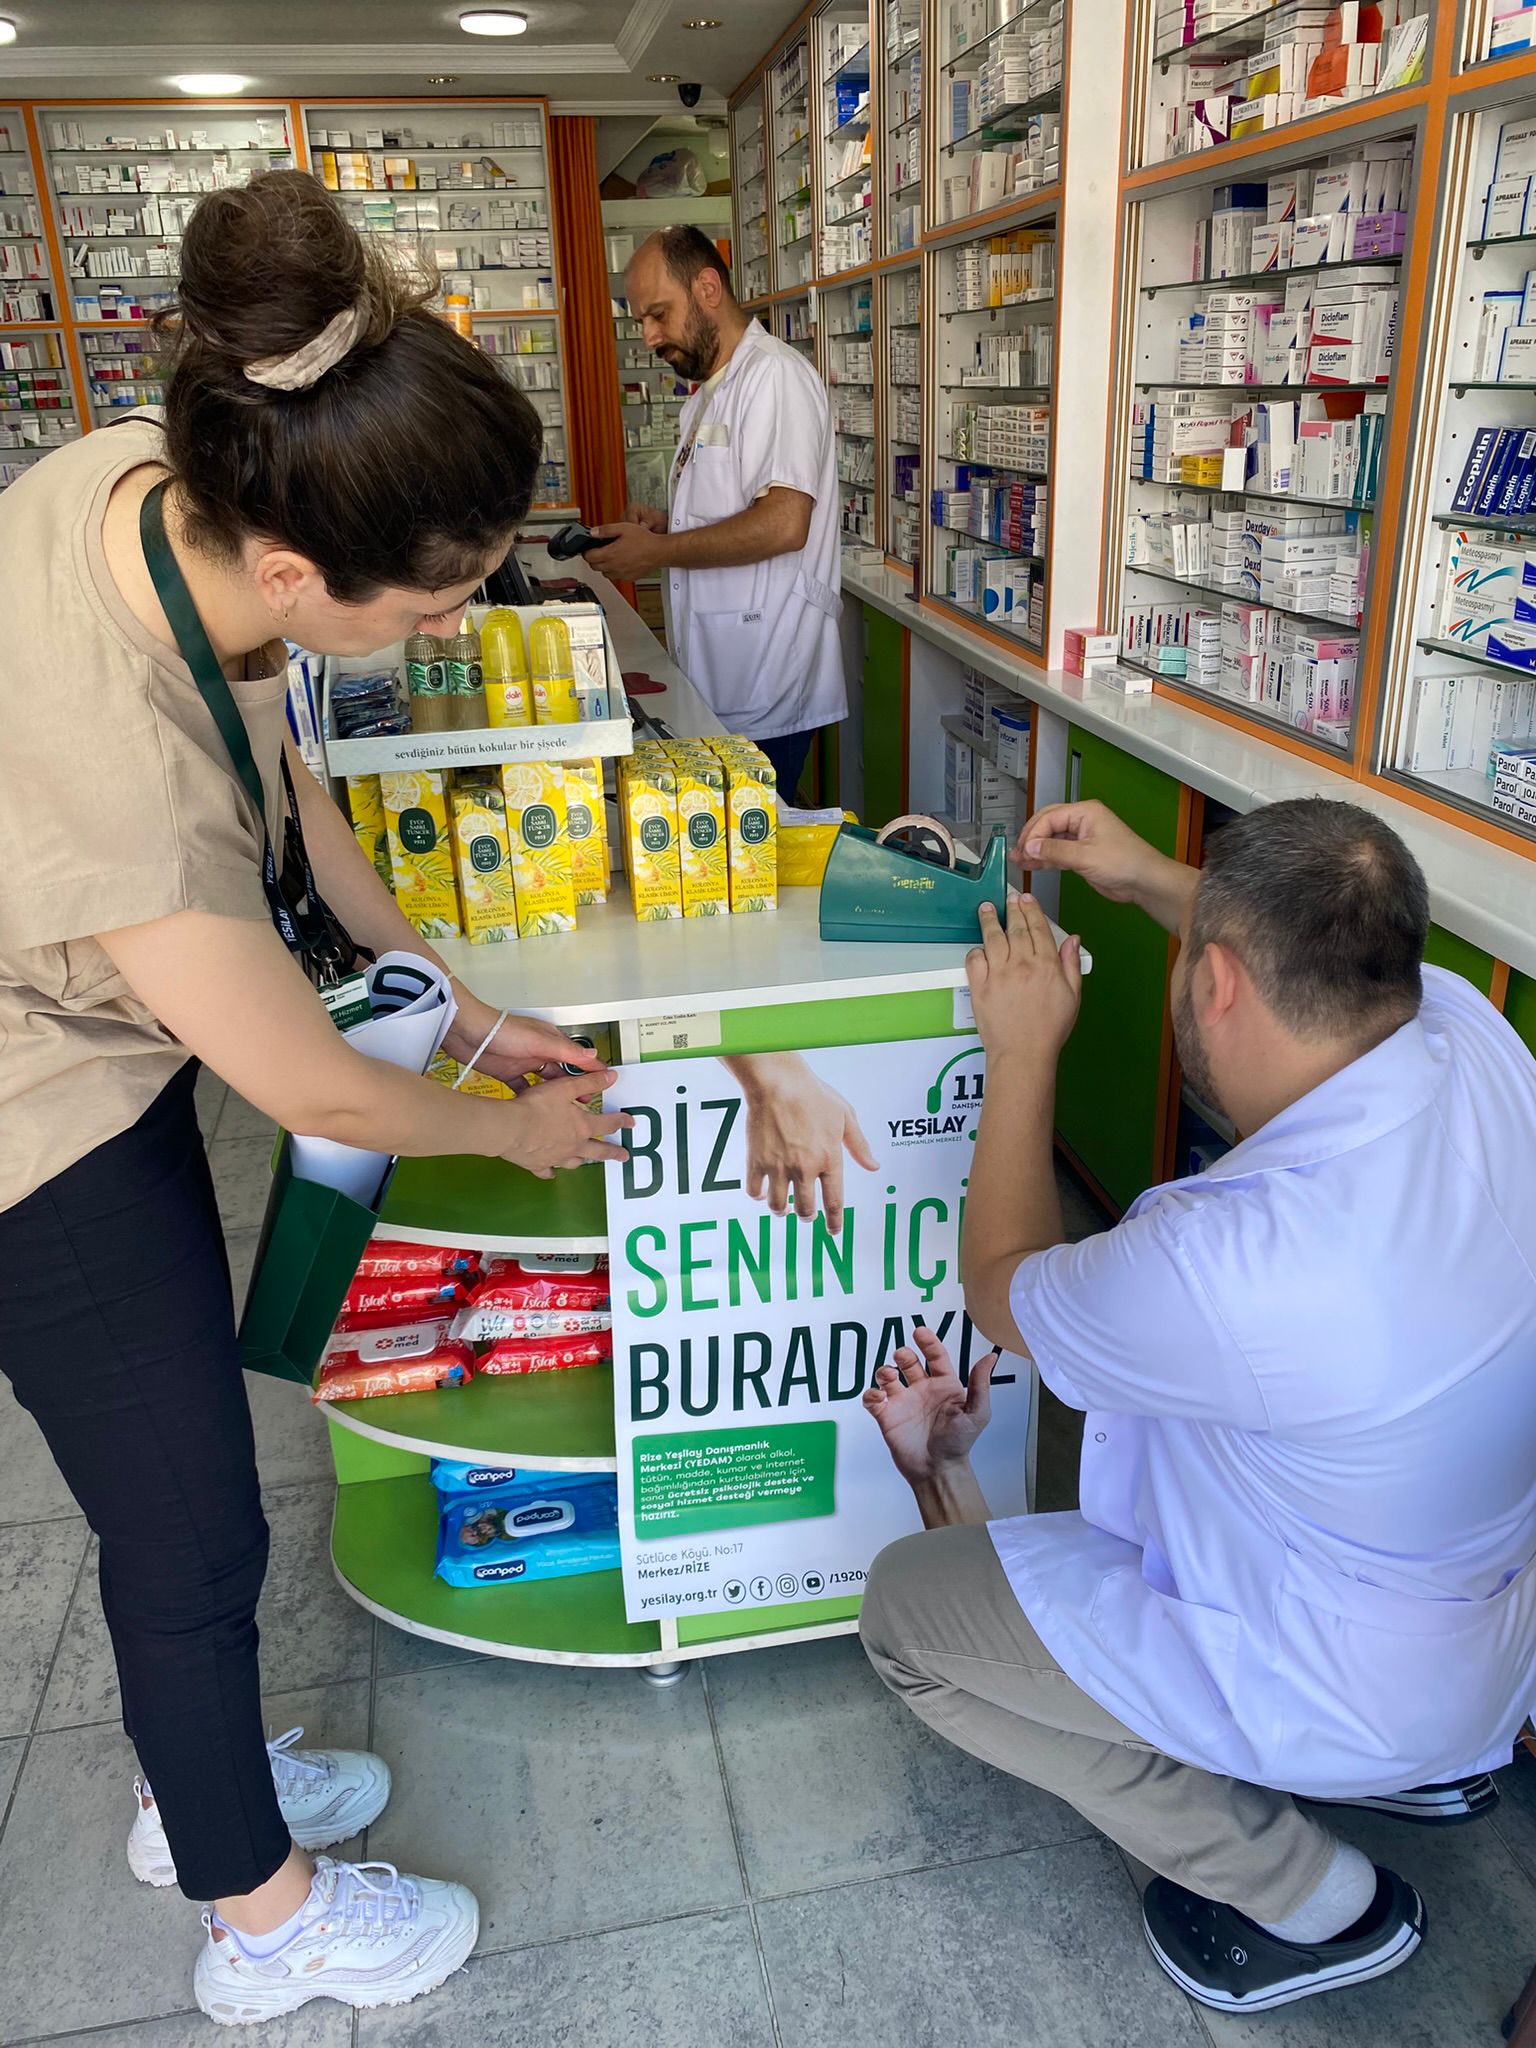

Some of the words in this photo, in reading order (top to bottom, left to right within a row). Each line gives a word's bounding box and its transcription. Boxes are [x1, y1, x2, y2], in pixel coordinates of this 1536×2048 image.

[1495, 192, 1521, 201] APRANAX
[1321, 312, 1349, 322] Dicloflam
[1384, 301, 1398, 358] Dicloflam
[1318, 352, 1347, 362] Dicloflam
[1457, 433, 1491, 506] Ecopirin
[1480, 474, 1499, 509] Ecopirin
[1499, 475, 1519, 510] Ecopirin
[1514, 474, 1533, 509] Ecopirin
[1245, 519, 1271, 536] Dexday
[1244, 557, 1261, 571] Dexd
[394, 748, 445, 760] sevdiğiniz
[447, 743, 476, 755] bütün
[479, 741, 517, 753] kokular
[520, 740, 535, 750] bir
[538, 738, 567, 752] şişede
[1497, 757, 1519, 774] Parol
[1496, 776, 1517, 794] Parol
[1493, 796, 1514, 814] Parol
[1518, 807, 1536, 824] Paro
[953, 1074, 984, 1101] 11
[619, 1084, 742, 1200] BİZ
[891, 1139, 935, 1147] DANIŞMANLIK
[624, 1194, 856, 1318] SENİN
[640, 1454, 662, 1463] Rize
[665, 1449, 703, 1460] Yeşilay
[705, 1440, 770, 1455] Danışmanlık
[641, 1460, 682, 1473] Merkezi
[684, 1456, 733, 1469] (YEDAM)
[735, 1452, 766, 1463] olarak
[716, 1465, 748, 1475] kumar
[765, 1457, 805, 1469] internet
[719, 1469, 786, 1484] kurtulabilmen
[641, 1493, 665, 1502] sana
[667, 1487, 710, 1499] ücretsiz
[712, 1480, 761, 1495] psikolojik
[764, 1476, 799, 1487] destek
[802, 1474, 815, 1482] ve
[641, 1500, 674, 1511] sosyal
[677, 1495, 713, 1506] hizmet
[715, 1489, 755, 1501] desteği
[757, 1485, 802, 1497] vermeye
[641, 1511, 680, 1521] hazırız.
[636, 1552, 678, 1565] Sütlüce
[714, 1543, 744, 1556] No:17
[638, 1561, 710, 1580] Merkez/RİZE
[641, 1587, 718, 1609] yesilay.org.tr
